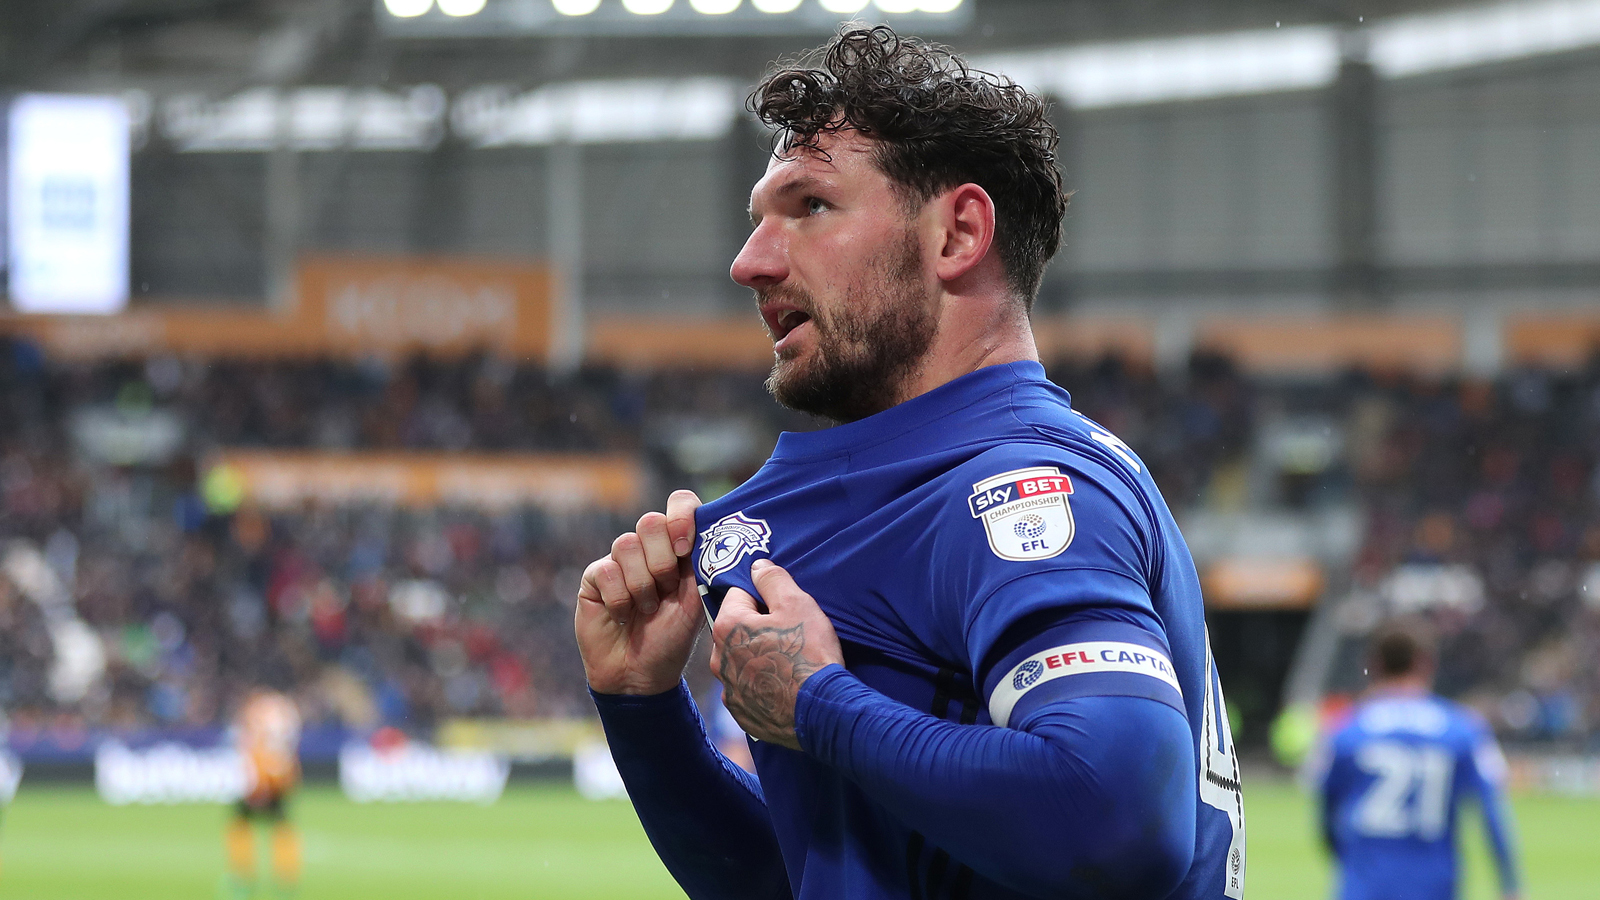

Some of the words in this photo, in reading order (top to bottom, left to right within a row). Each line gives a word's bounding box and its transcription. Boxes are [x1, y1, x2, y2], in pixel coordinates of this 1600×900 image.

[975, 486, 1013, 511] sky
[1022, 478, 1064, 495] BET
[989, 496, 1060, 521] CHAMPIONSHIP
[1021, 539, 1049, 552] EFL
[1045, 651, 1095, 670] EFL
[1353, 741, 1453, 843] 21
